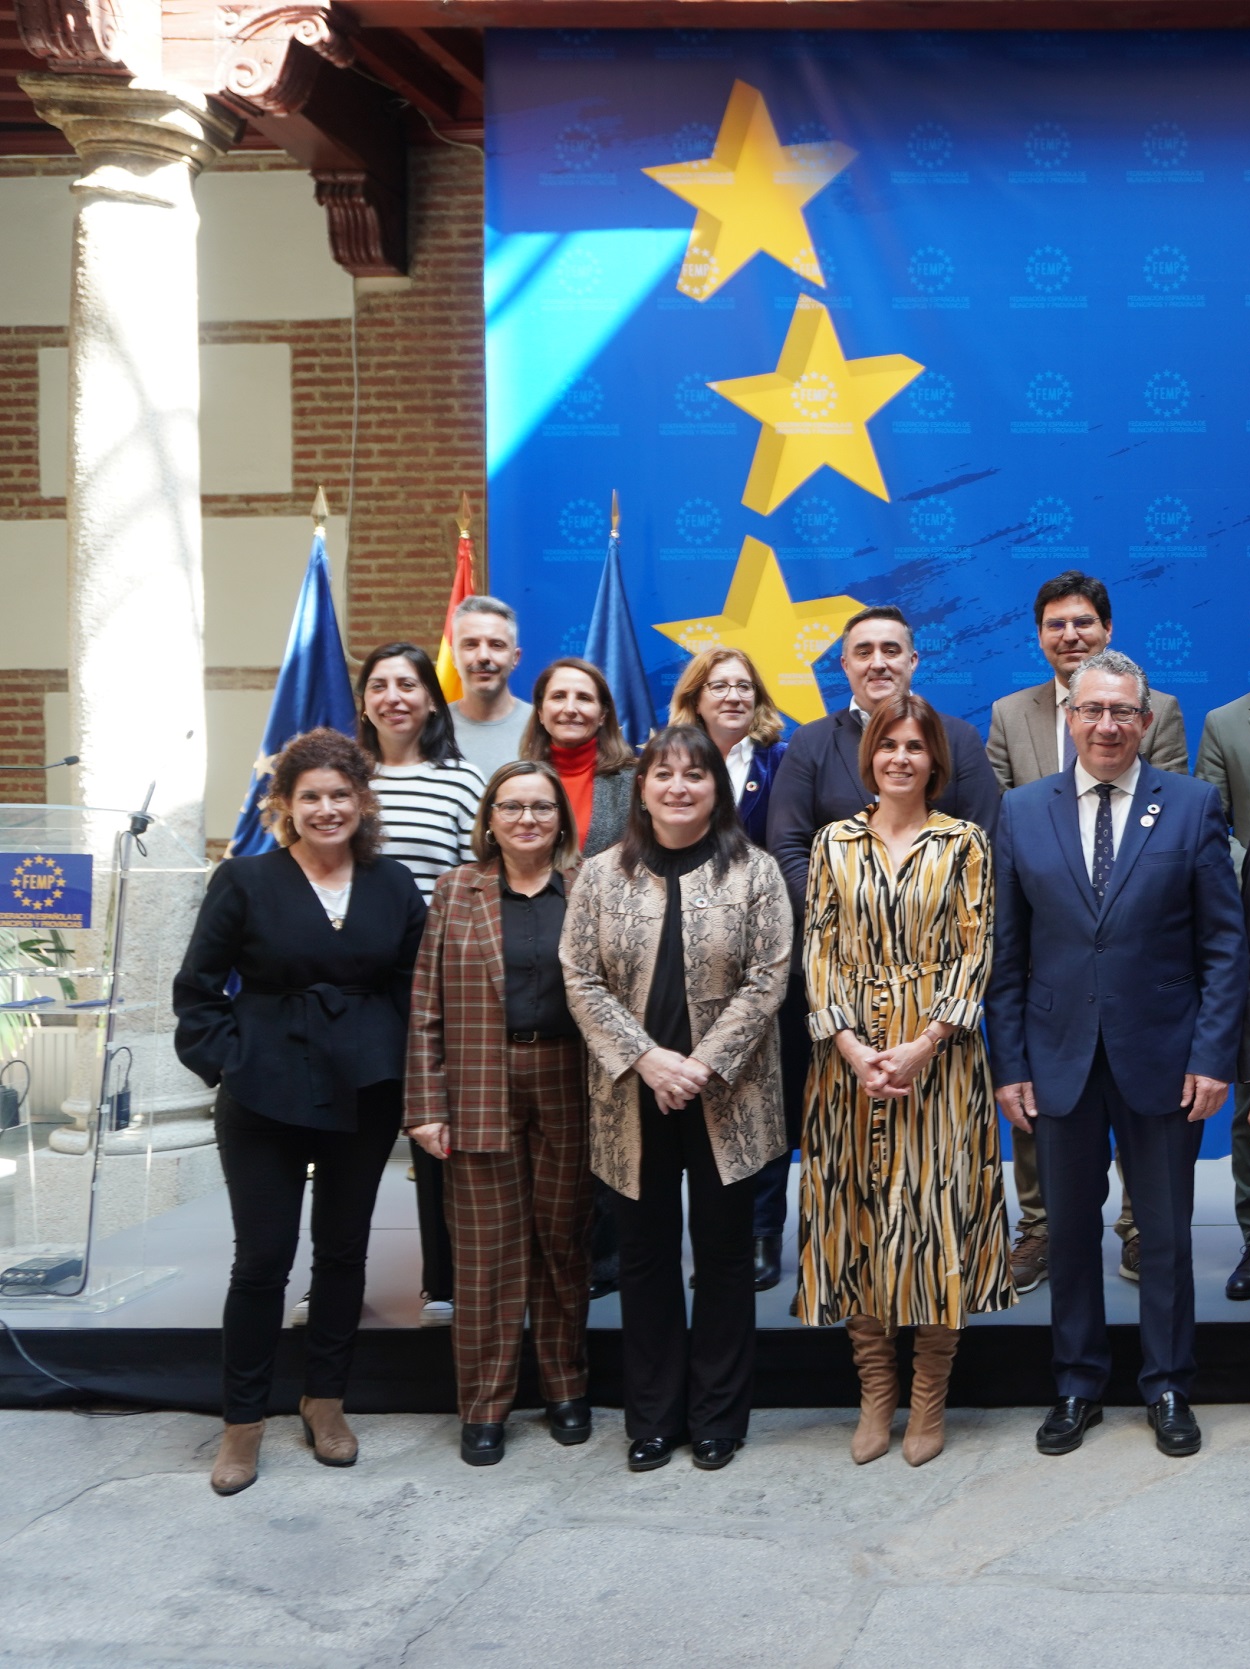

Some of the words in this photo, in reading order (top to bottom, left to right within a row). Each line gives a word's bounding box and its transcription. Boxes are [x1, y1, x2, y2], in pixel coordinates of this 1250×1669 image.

[683, 264, 710, 277] FEMP
[917, 263, 945, 276] FEMP
[1035, 263, 1063, 276] FEMP
[1152, 262, 1180, 275] FEMP
[566, 390, 594, 402] FEMP
[684, 389, 712, 402] FEMP
[801, 388, 829, 401] FEMP
[918, 388, 946, 401] FEMP
[1036, 388, 1064, 401] FEMP
[1153, 387, 1181, 400] FEMP
[568, 515, 596, 528] FEMP
[685, 514, 713, 527] FEMP
[802, 513, 830, 526] FEMP
[919, 513, 947, 526] FEMP
[1036, 513, 1064, 526] FEMP
[1154, 512, 1182, 525] FEMP
[920, 639, 947, 652] FEMP
[1155, 638, 1183, 651] FEMP
[22, 875, 55, 889] FEMP
